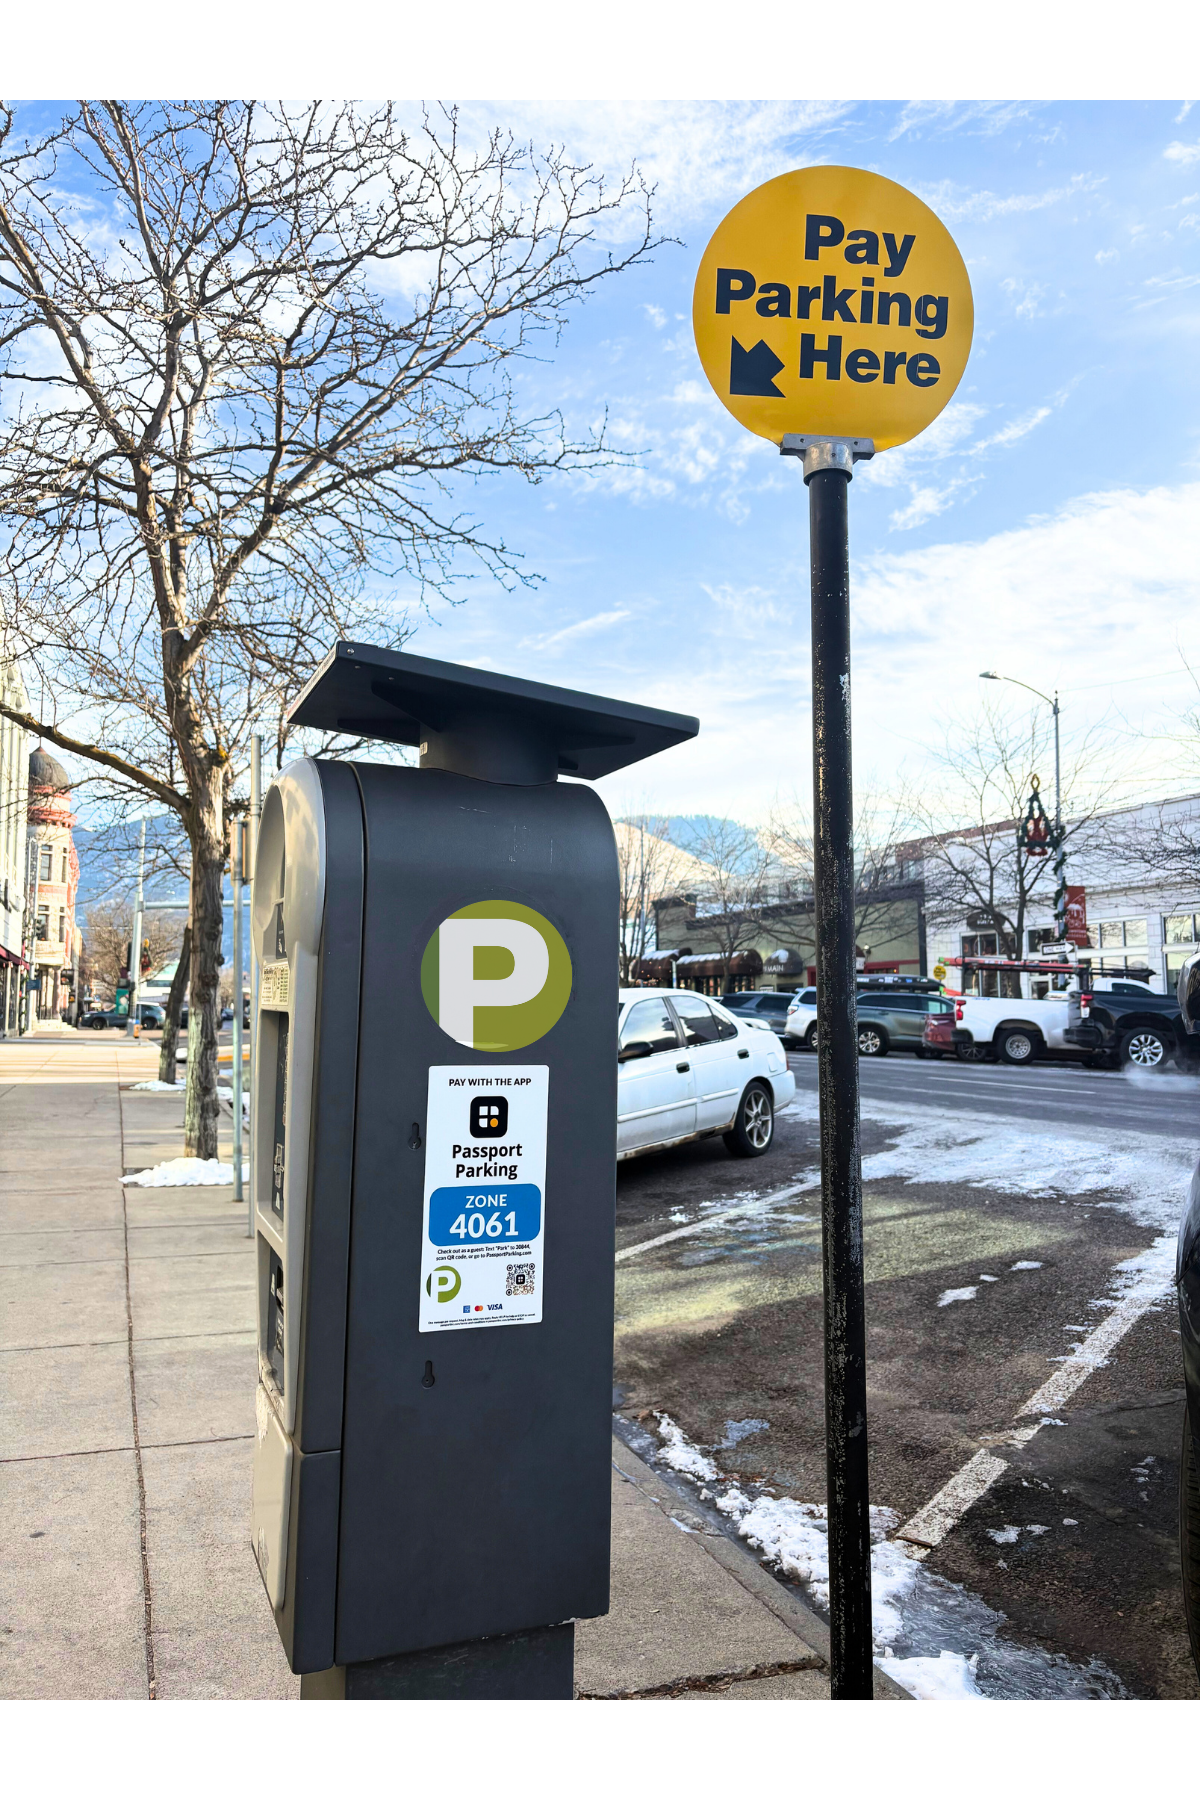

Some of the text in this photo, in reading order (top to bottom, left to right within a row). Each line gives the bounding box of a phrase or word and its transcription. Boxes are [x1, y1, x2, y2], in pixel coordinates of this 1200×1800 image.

[804, 214, 917, 278] Pay
[715, 268, 949, 340] Parking
[799, 333, 941, 388] Here
[439, 918, 550, 1049] P
[448, 1078, 532, 1087] PAY WITH THE APP
[452, 1143, 523, 1162] Passport
[455, 1162, 518, 1181] Parking
[465, 1194, 508, 1209] ZONE
[449, 1211, 519, 1239] 4061
[486, 1303, 504, 1311] VISA
